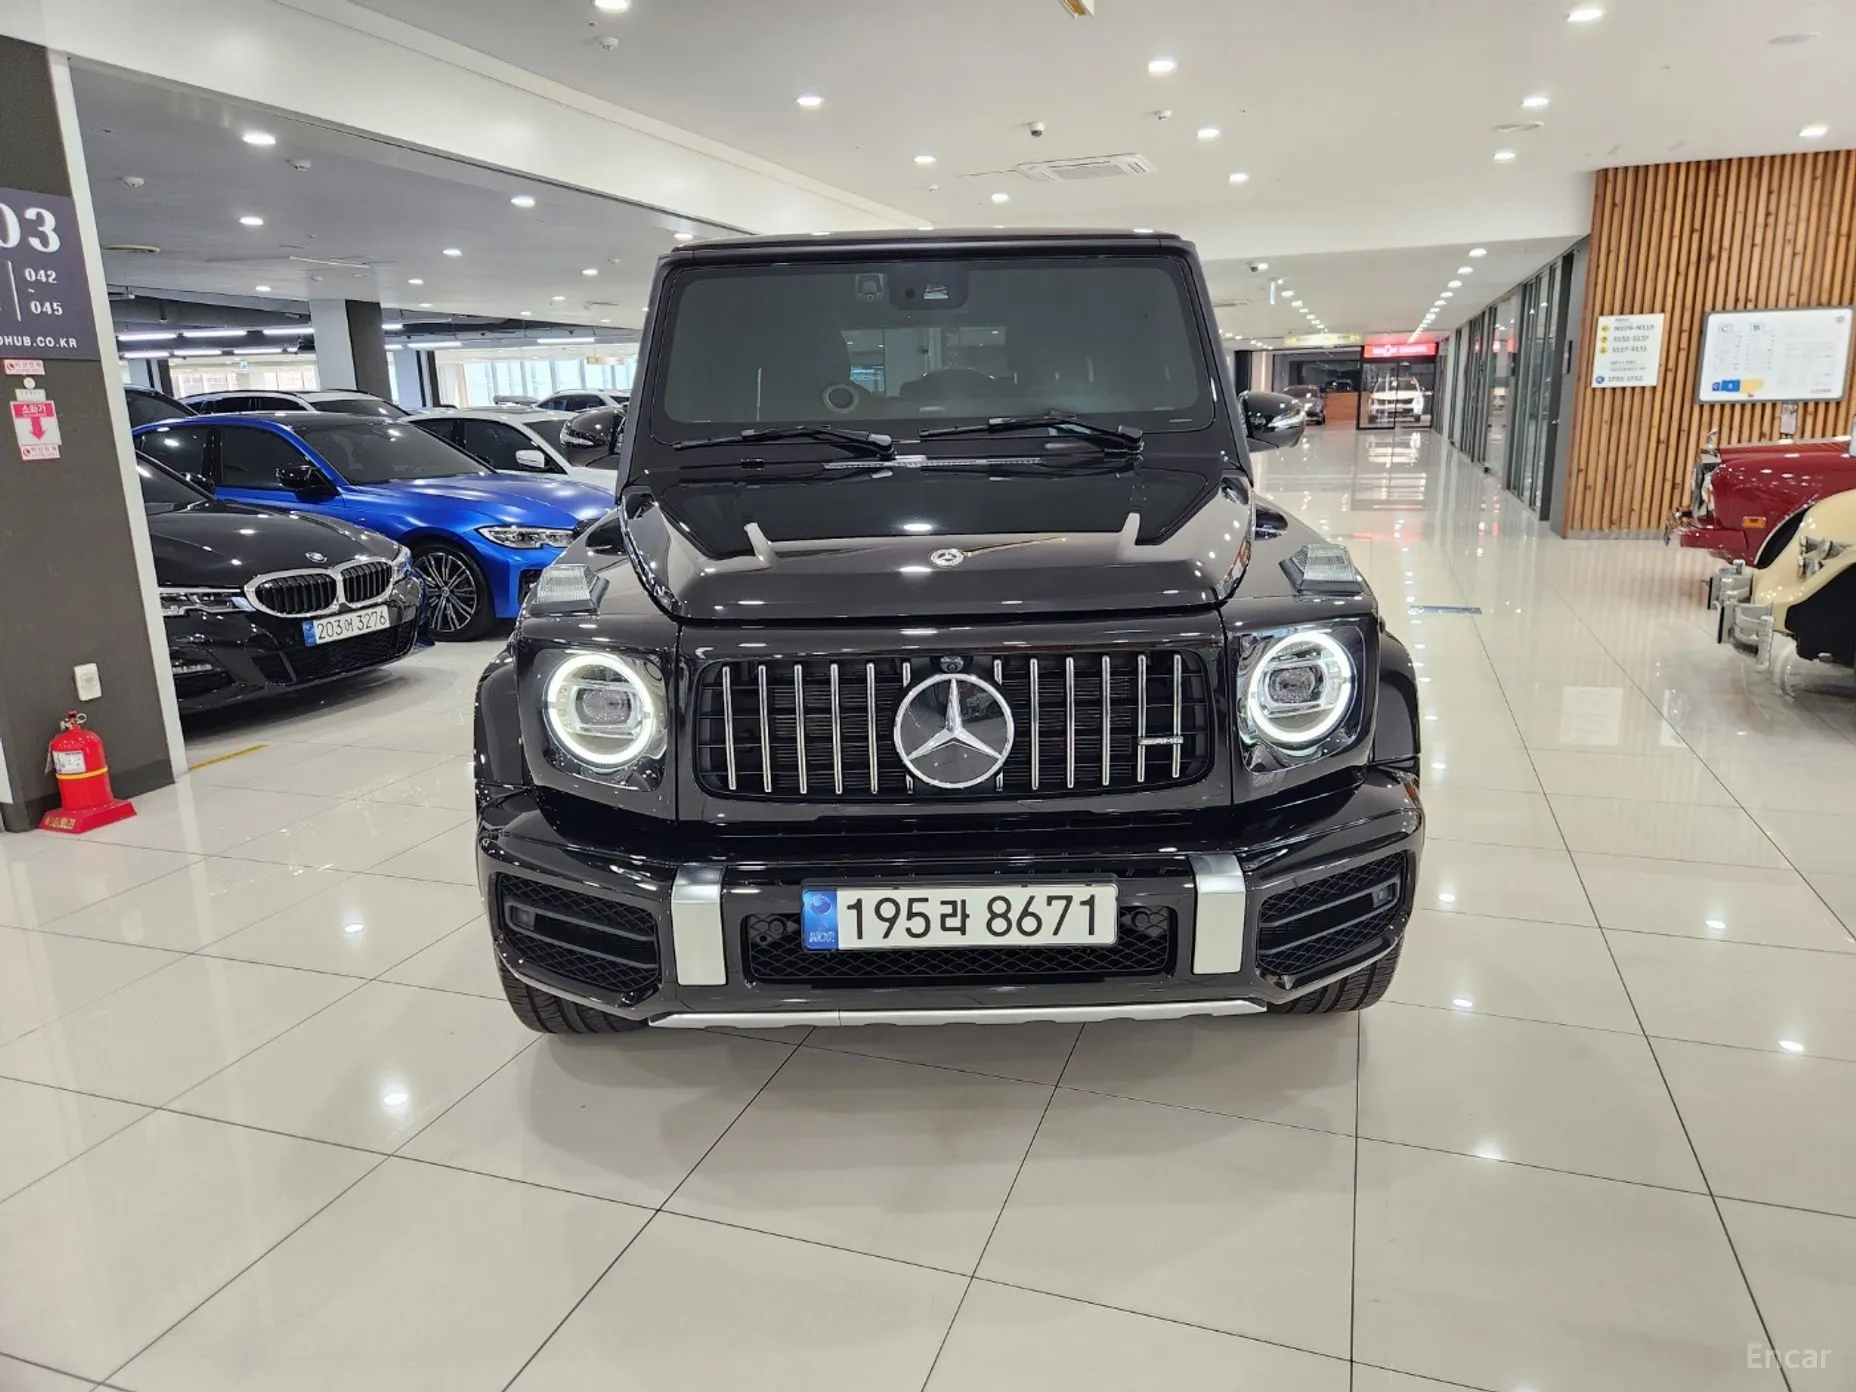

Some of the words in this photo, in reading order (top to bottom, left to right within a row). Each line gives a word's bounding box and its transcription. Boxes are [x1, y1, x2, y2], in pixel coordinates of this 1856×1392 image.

[24, 268, 57, 283] 042
[30, 300, 63, 316] 045
[356, 609, 387, 631] 3276
[846, 896, 970, 940] 195라
[986, 894, 1095, 938] 8671
